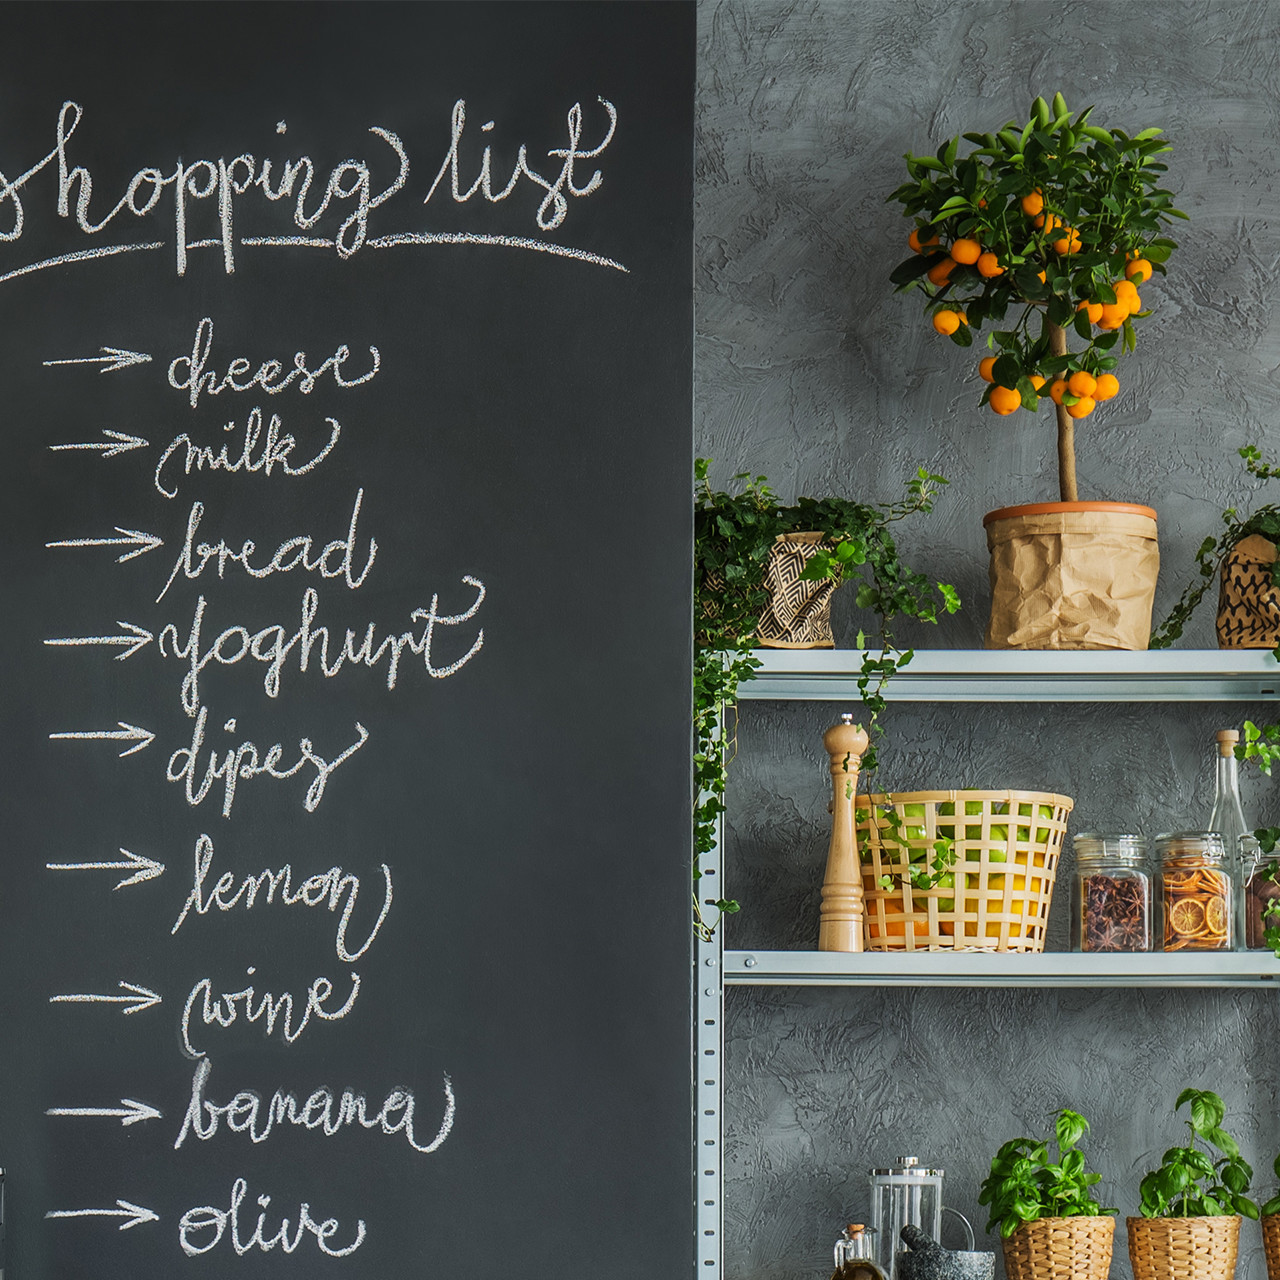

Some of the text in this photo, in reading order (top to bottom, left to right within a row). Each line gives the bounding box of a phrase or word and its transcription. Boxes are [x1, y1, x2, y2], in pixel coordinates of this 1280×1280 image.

[424, 96, 617, 231] list
[155, 406, 341, 498] milk
[156, 487, 378, 603] bread
[171, 834, 393, 962] lemon
[180, 966, 361, 1057] wine
[174, 1057, 456, 1153] banana
[179, 1178, 367, 1258] olive
